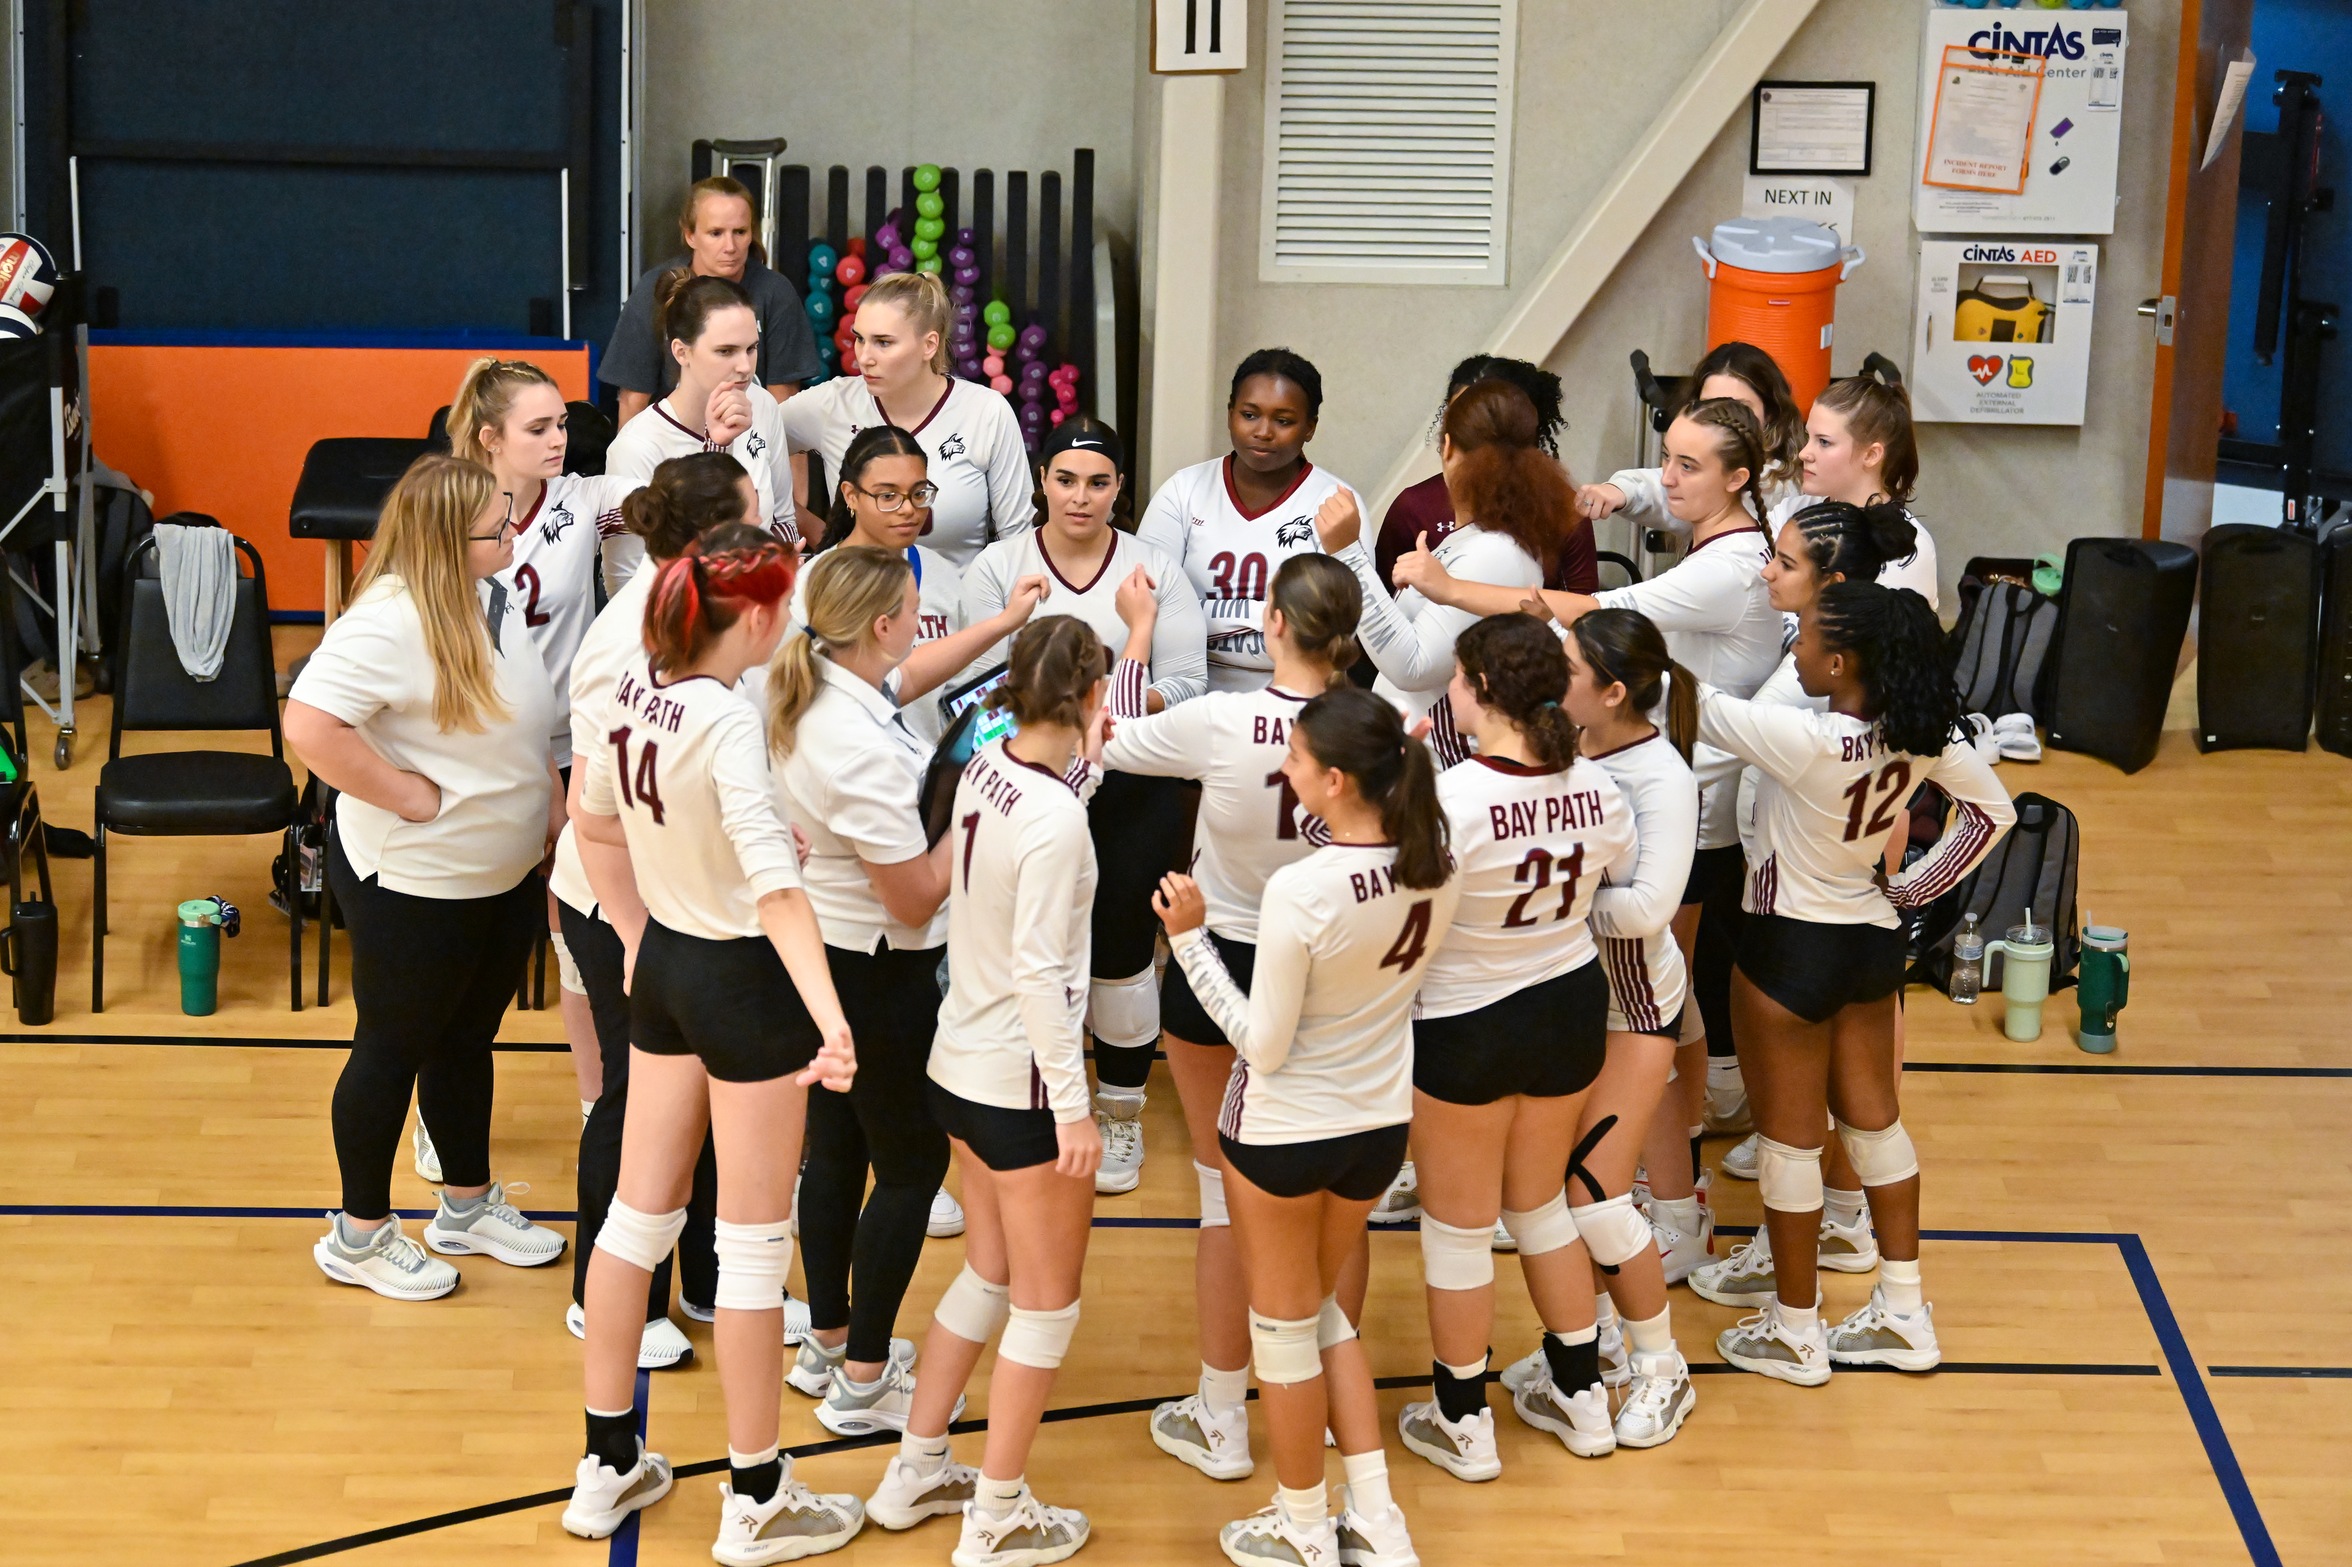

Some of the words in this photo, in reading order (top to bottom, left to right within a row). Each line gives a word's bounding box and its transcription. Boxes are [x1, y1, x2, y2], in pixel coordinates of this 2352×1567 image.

[1765, 189, 1809, 205] NEXT
[1815, 191, 1832, 205] IN
[2020, 250, 2057, 263] AED
[514, 562, 551, 629] 2
[1206, 551, 1268, 601] 30
[608, 724, 666, 827] 14
[1841, 731, 1873, 762] BAY
[981, 769, 1022, 816] PATH
[1489, 800, 1538, 841] BAY
[1545, 790, 1604, 833] PATH
[1842, 761, 1911, 842] 12
[962, 809, 981, 896] 1
[1501, 841, 1585, 929] 21
[1378, 898, 1433, 975] 4
